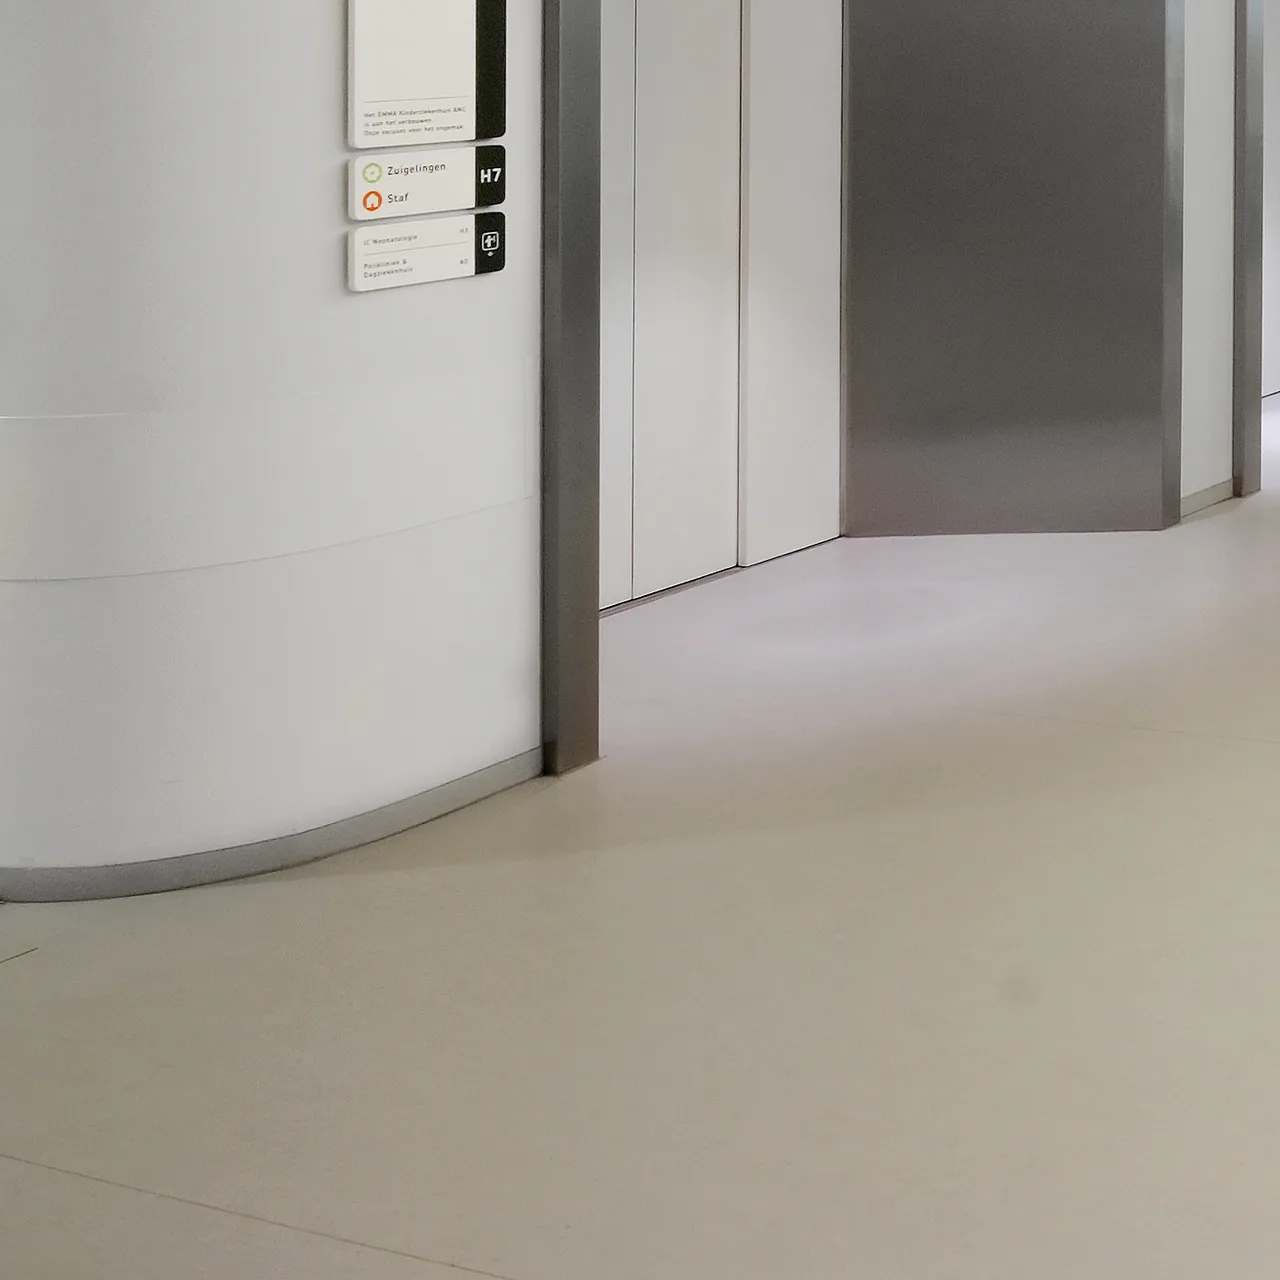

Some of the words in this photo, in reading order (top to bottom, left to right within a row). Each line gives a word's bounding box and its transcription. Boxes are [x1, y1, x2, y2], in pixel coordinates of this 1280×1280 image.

[387, 162, 446, 176] Zuigelingen
[480, 167, 502, 183] H7
[387, 192, 409, 204] Staf
